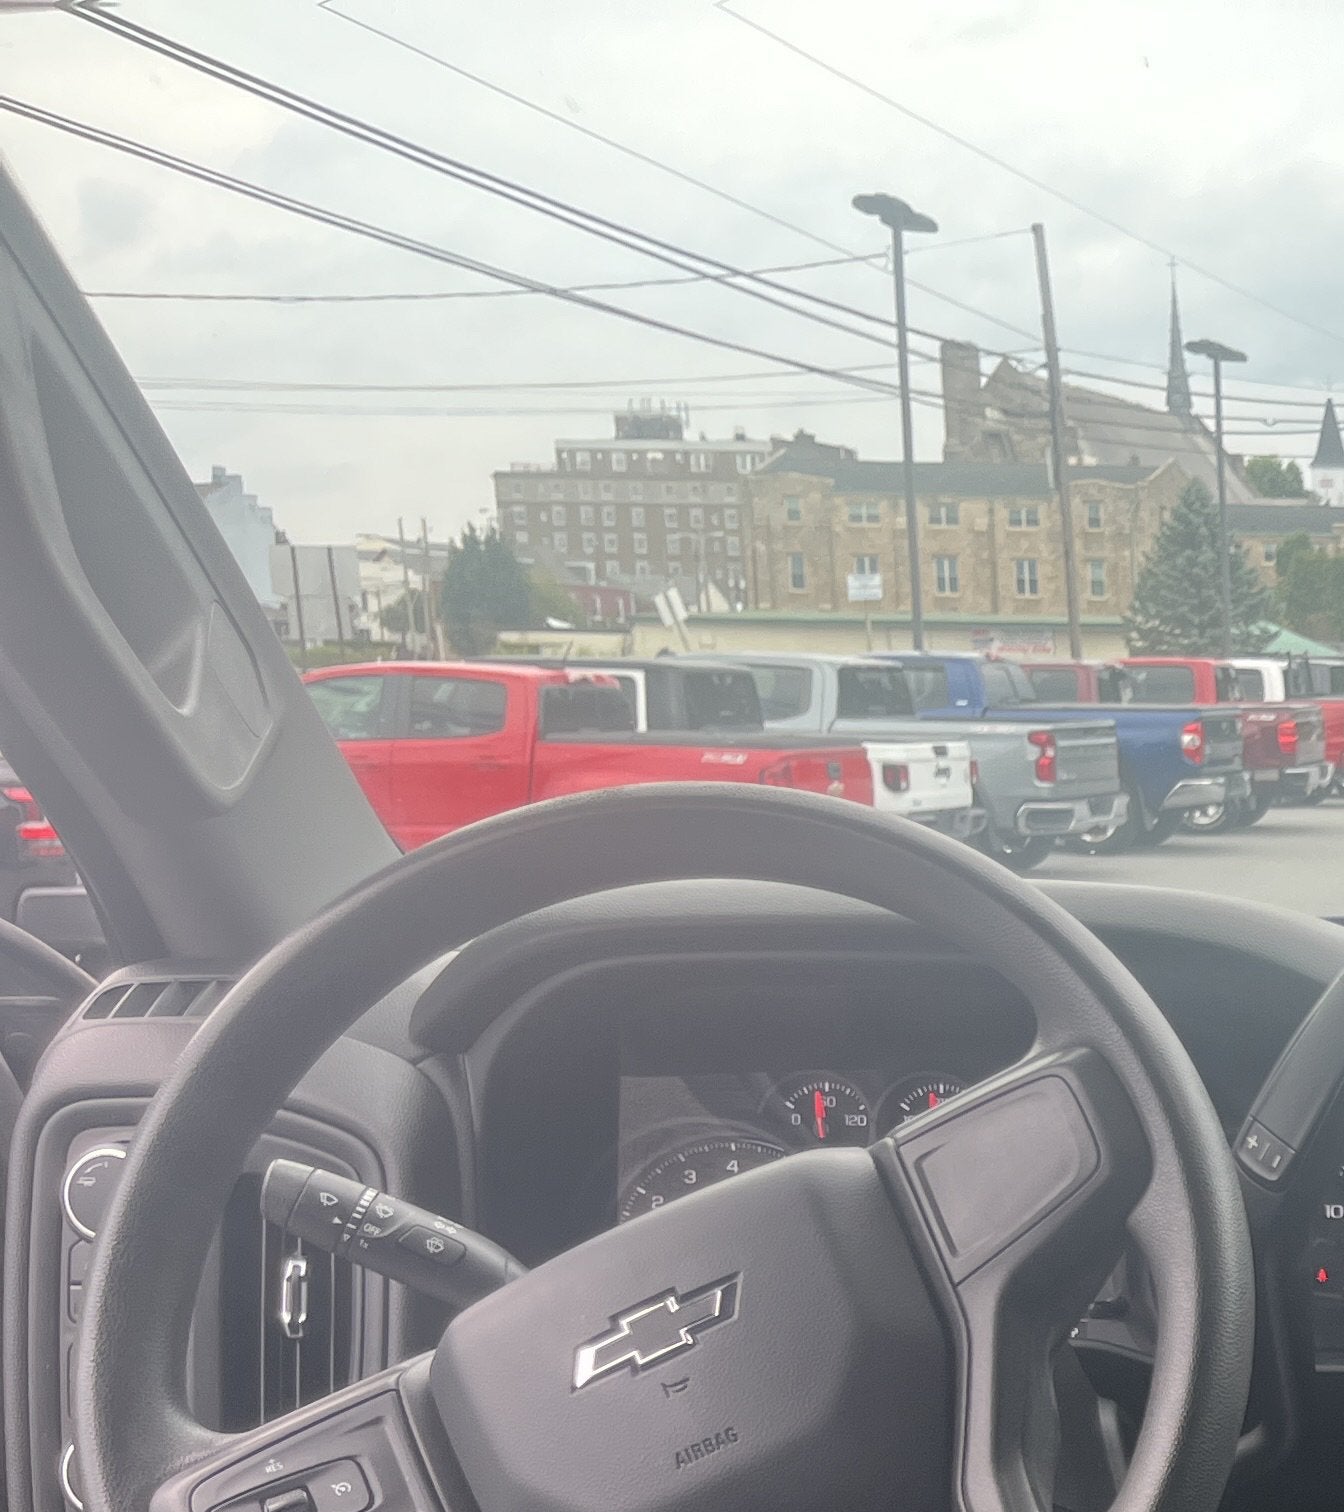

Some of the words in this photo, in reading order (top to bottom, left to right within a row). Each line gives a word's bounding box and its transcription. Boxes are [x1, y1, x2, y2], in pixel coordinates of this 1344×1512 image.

[791, 1113, 801, 1126] 0
[844, 1114, 867, 1126] 120
[726, 1160, 739, 1173] 4
[683, 1169, 697, 1184] 3
[363, 1222, 383, 1237] OFF
[675, 1426, 739, 1469] AIRBAG
[265, 1462, 284, 1473] RES
